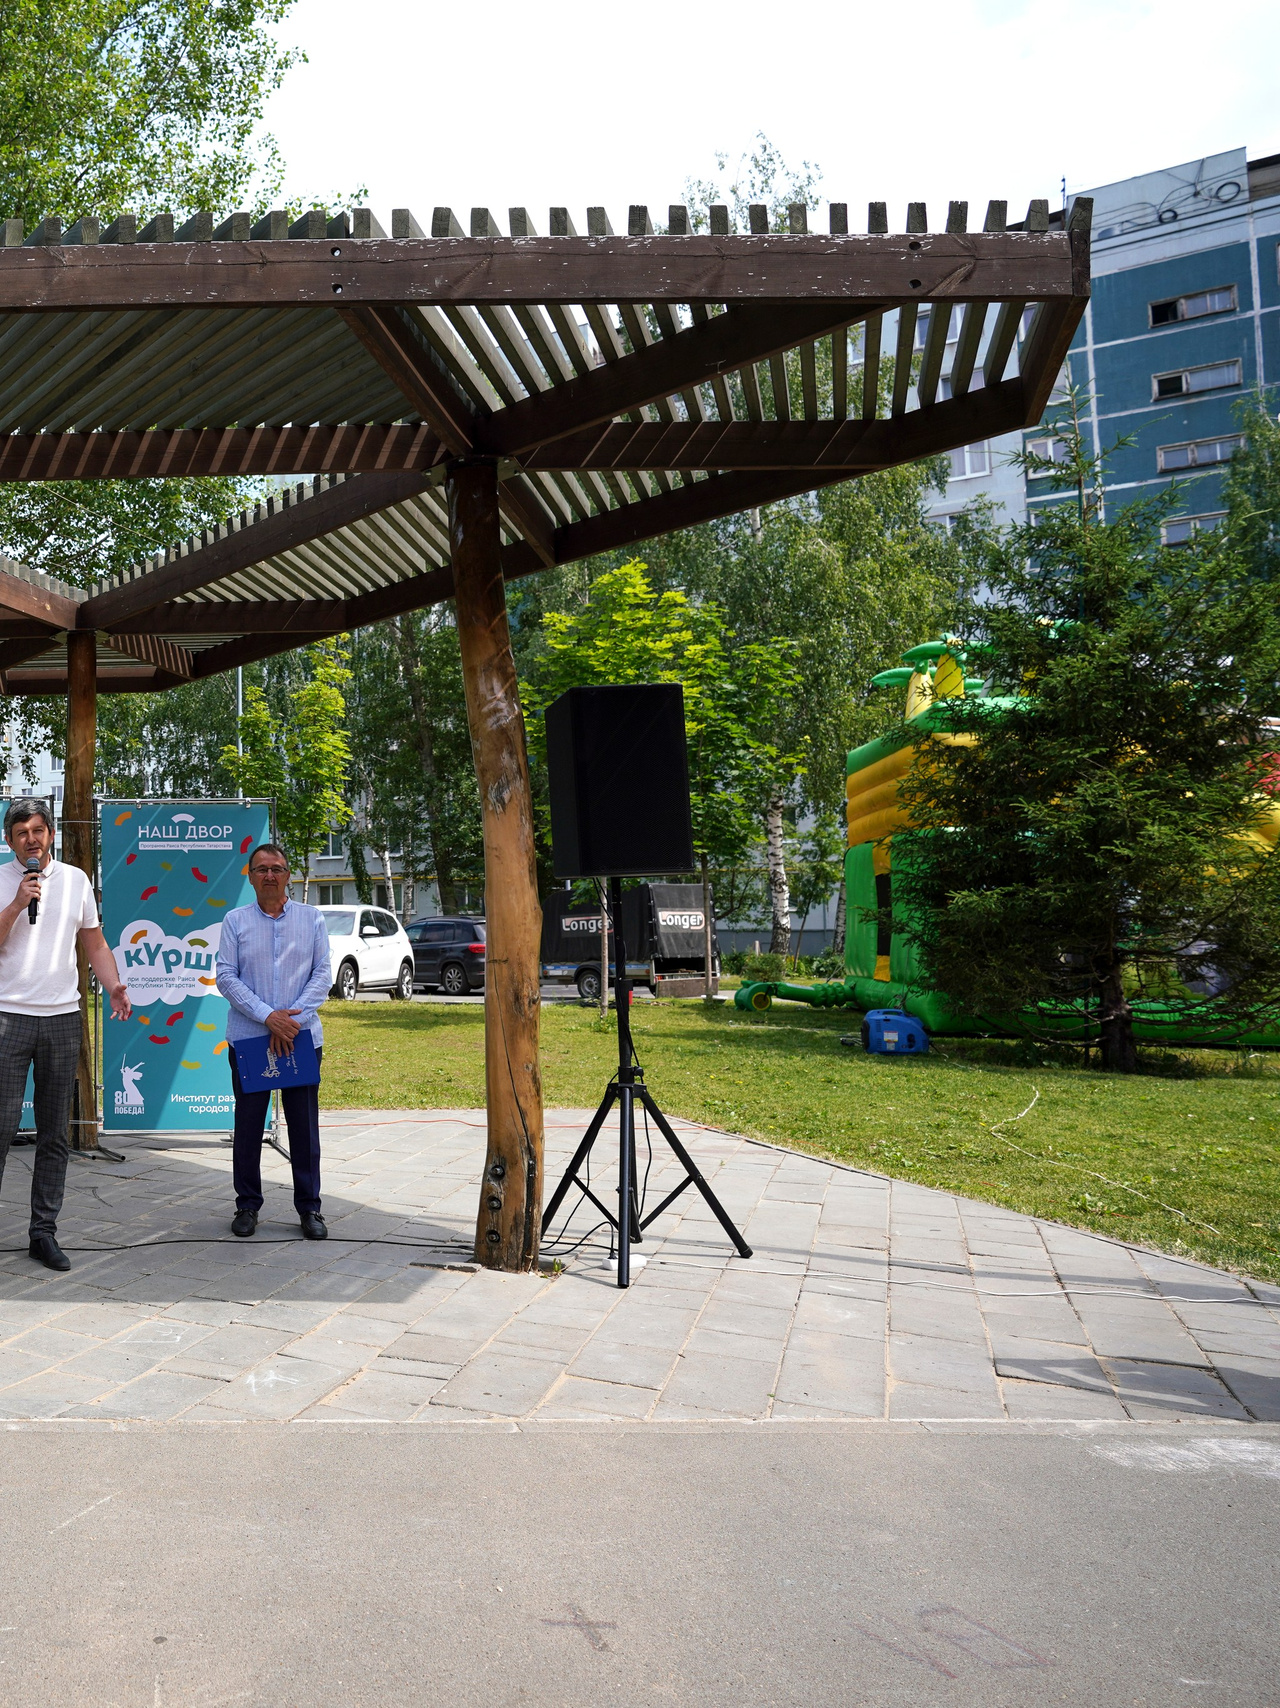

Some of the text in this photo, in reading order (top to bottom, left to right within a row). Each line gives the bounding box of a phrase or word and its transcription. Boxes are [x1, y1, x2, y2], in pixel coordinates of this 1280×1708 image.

[138, 825, 233, 840] НАШ ДВОР
[658, 911, 703, 929] Longer
[171, 1094, 216, 1104] Институт
[114, 1106, 145, 1115] ПОБЕДА!
[188, 1105, 230, 1114] городов
